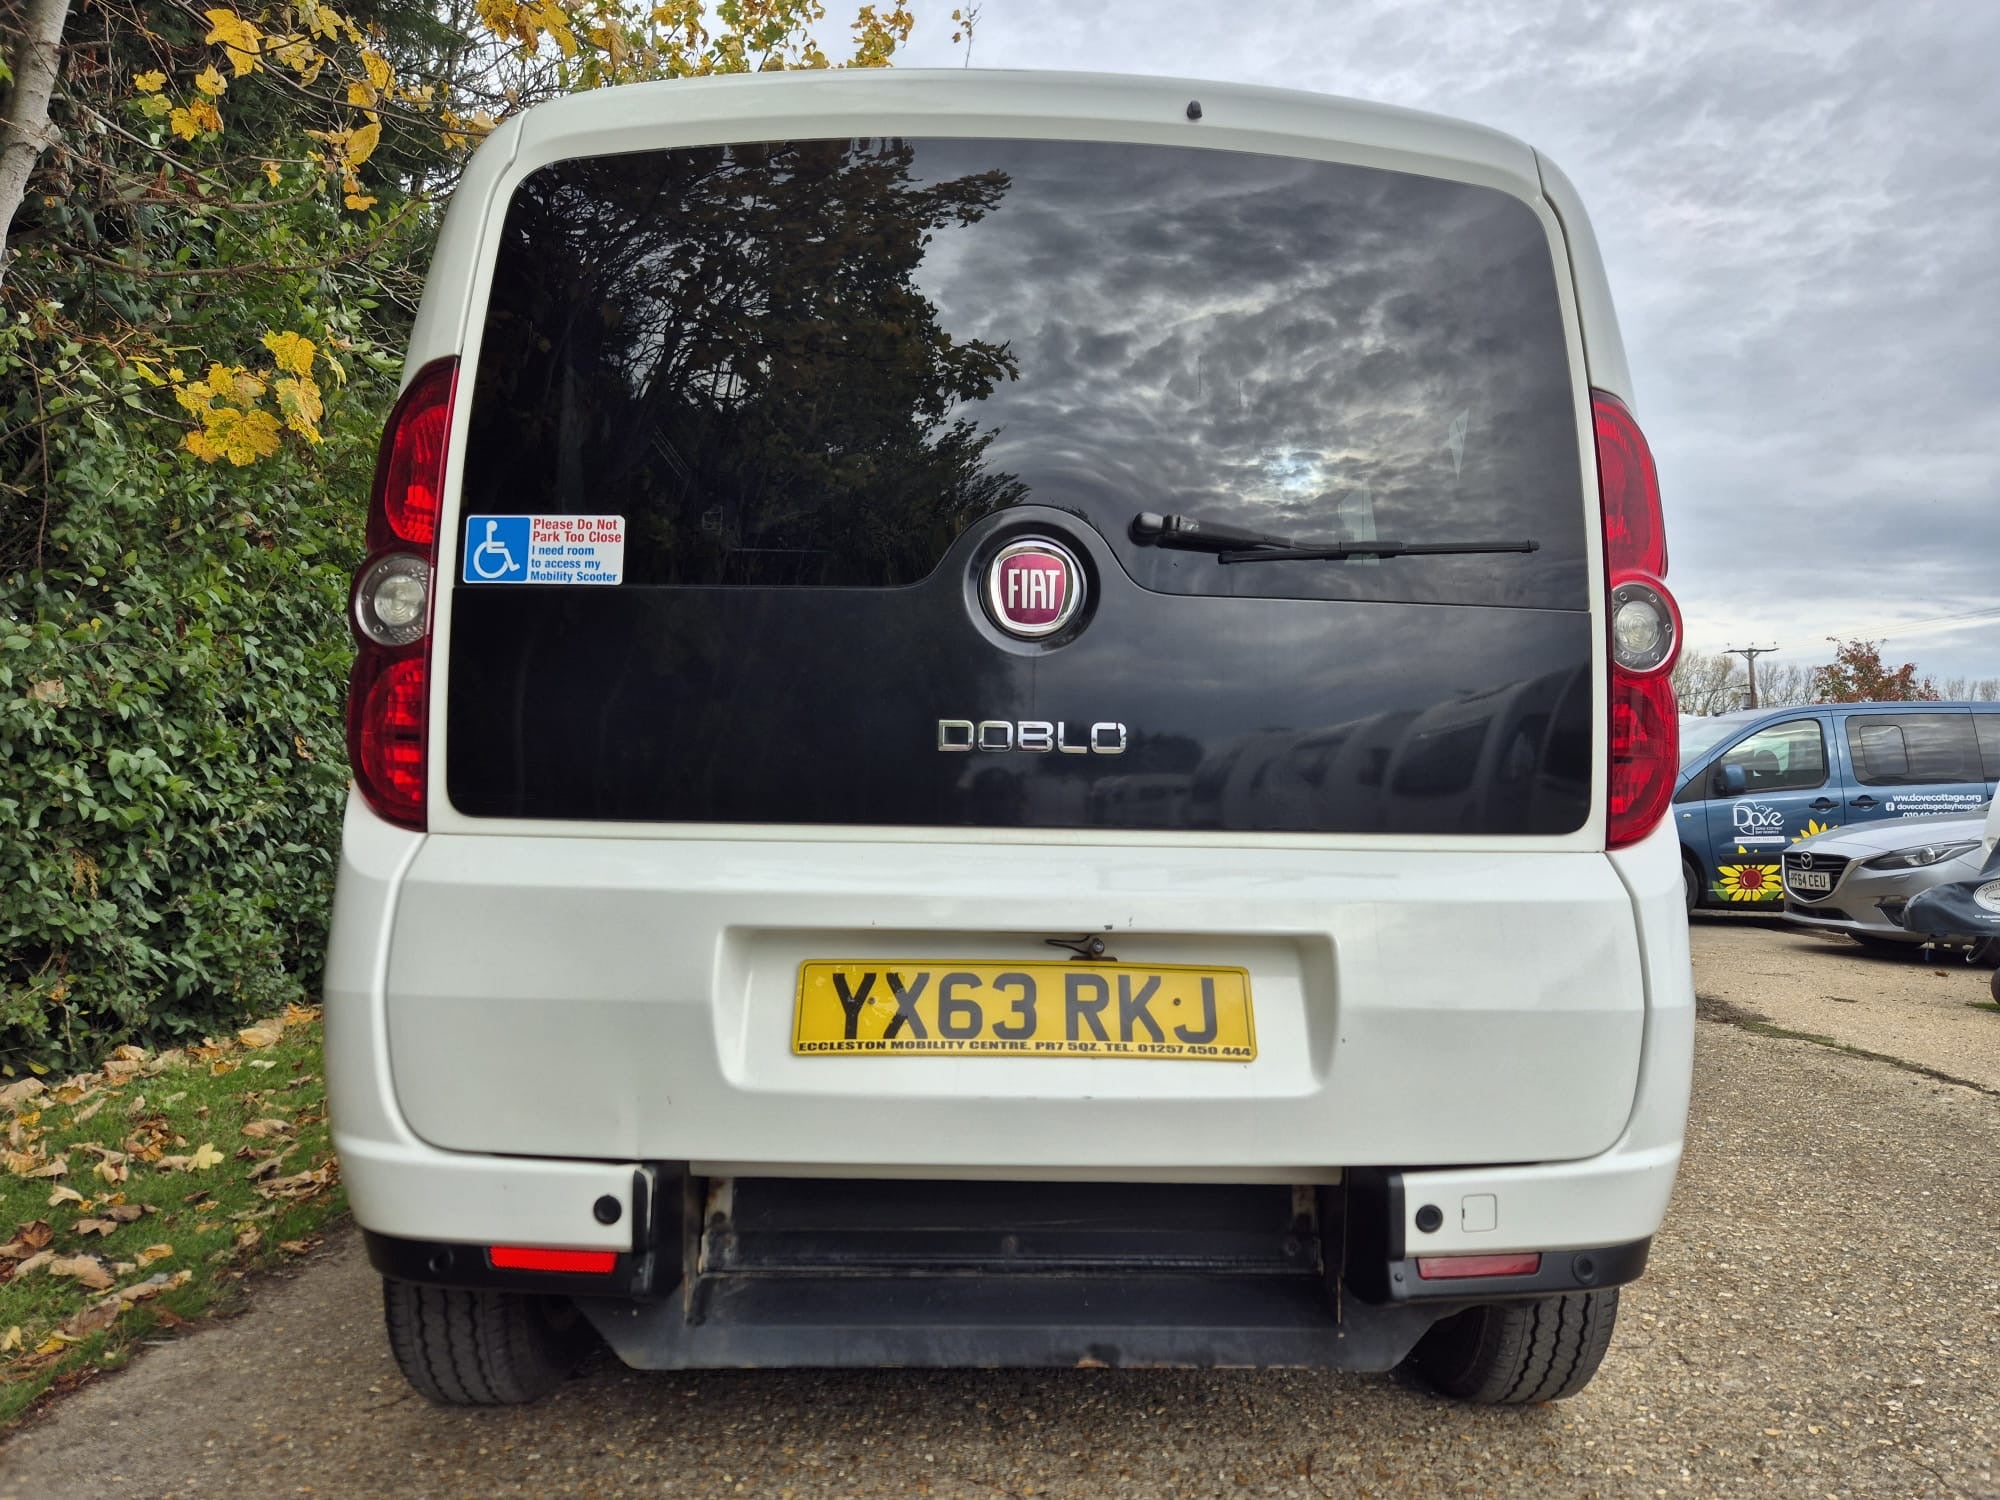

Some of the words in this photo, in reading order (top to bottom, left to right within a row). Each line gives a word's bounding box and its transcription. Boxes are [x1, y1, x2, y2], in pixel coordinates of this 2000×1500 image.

[533, 518, 573, 530] Please
[577, 518, 592, 530] Do
[596, 519, 617, 530] Not
[532, 531, 560, 542] Park
[565, 531, 585, 542] Too
[588, 531, 622, 543] Close
[538, 545, 564, 555] need
[567, 546, 595, 555] room
[531, 559, 541, 569] to
[544, 560, 581, 569] access
[584, 561, 600, 571] my
[530, 571, 573, 583] Mobility
[576, 571, 617, 582] Scooter
[1008, 568, 1060, 610] FIAT
[938, 719, 1127, 754] DOBLO
[1733, 806, 1784, 826] Dove
[1809, 874, 1826, 887] CEU
[832, 972, 1037, 1041] YX63
[1064, 973, 1218, 1044] RKJ
[799, 1041, 886, 1051] ECCLESTON
[890, 1040, 964, 1050] MOBILITY
[1035, 1041, 1063, 1051] PR7
[1104, 1043, 1134, 1052] TEL.
[1138, 1044, 1183, 1054] 01257
[1187, 1046, 1218, 1055] 450
[1222, 1047, 1251, 1056] 444
